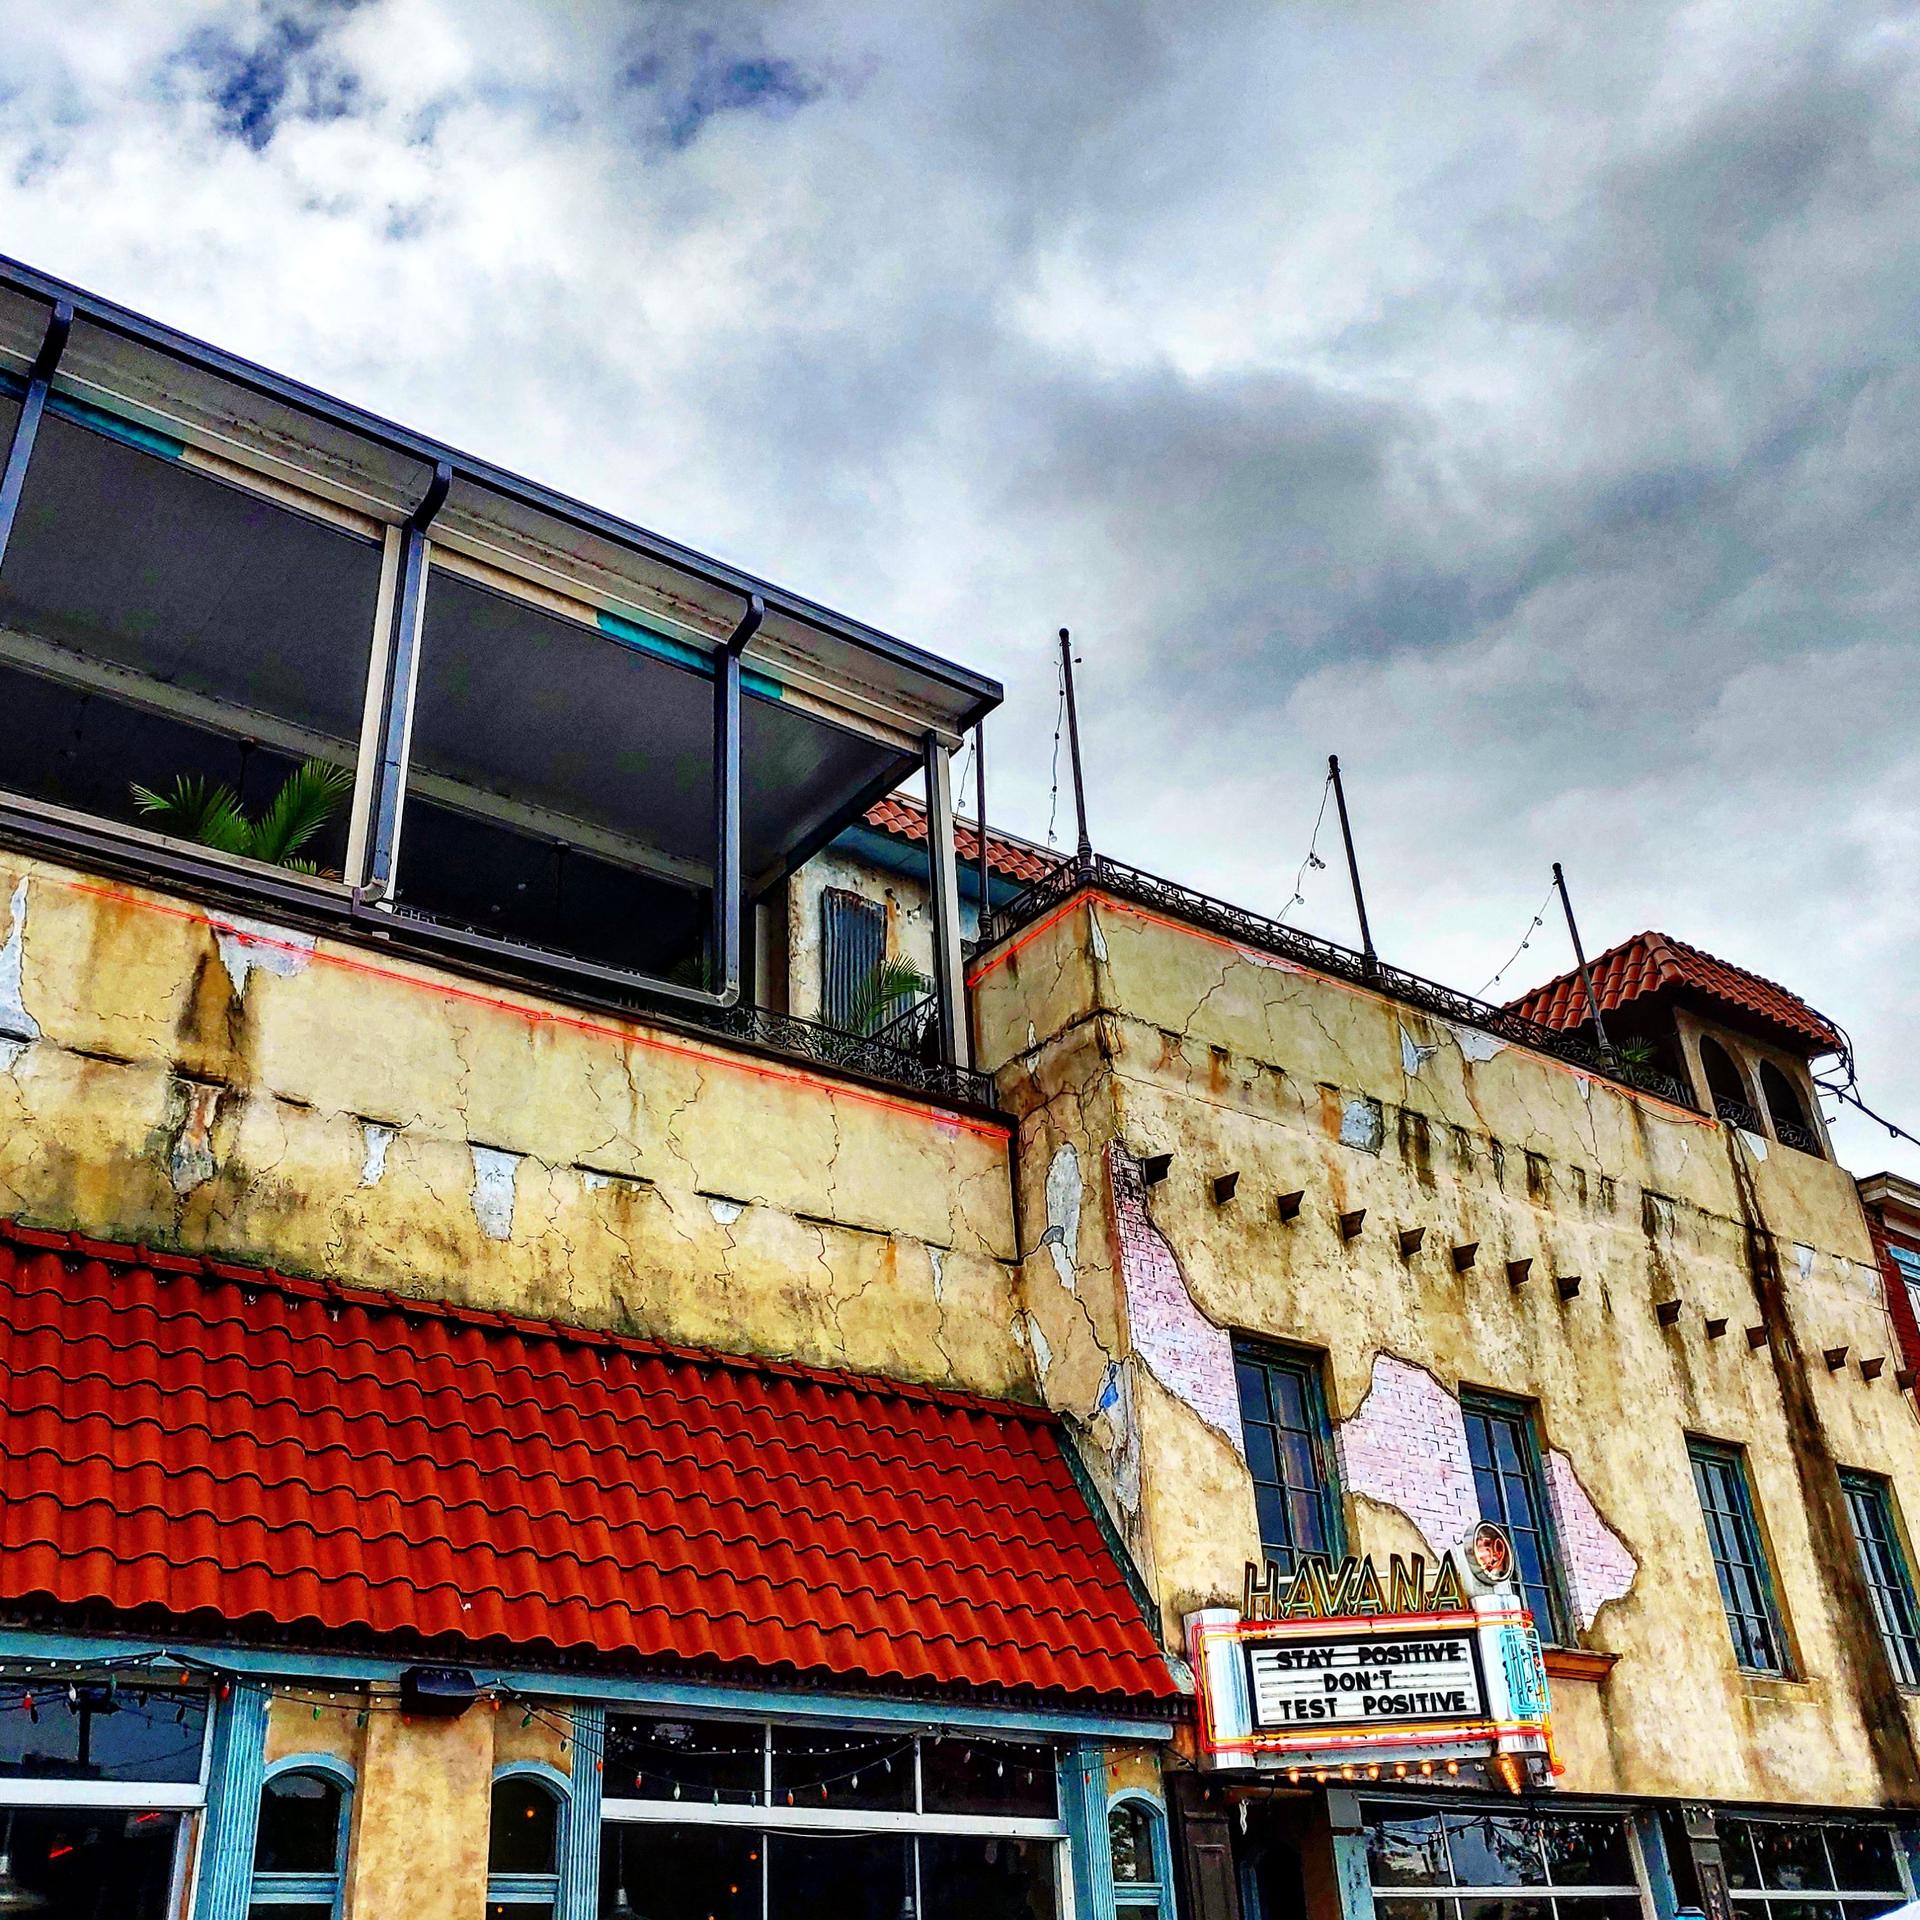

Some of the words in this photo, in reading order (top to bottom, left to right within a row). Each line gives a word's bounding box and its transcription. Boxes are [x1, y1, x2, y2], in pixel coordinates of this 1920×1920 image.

[1243, 1549, 1471, 1621] HAVANA
[1276, 1648, 1334, 1669] STAY
[1358, 1642, 1461, 1666] POSITIVE
[1323, 1670, 1392, 1692] DON'T
[1279, 1697, 1337, 1720] TEST
[1362, 1691, 1467, 1715] POSITIVE
